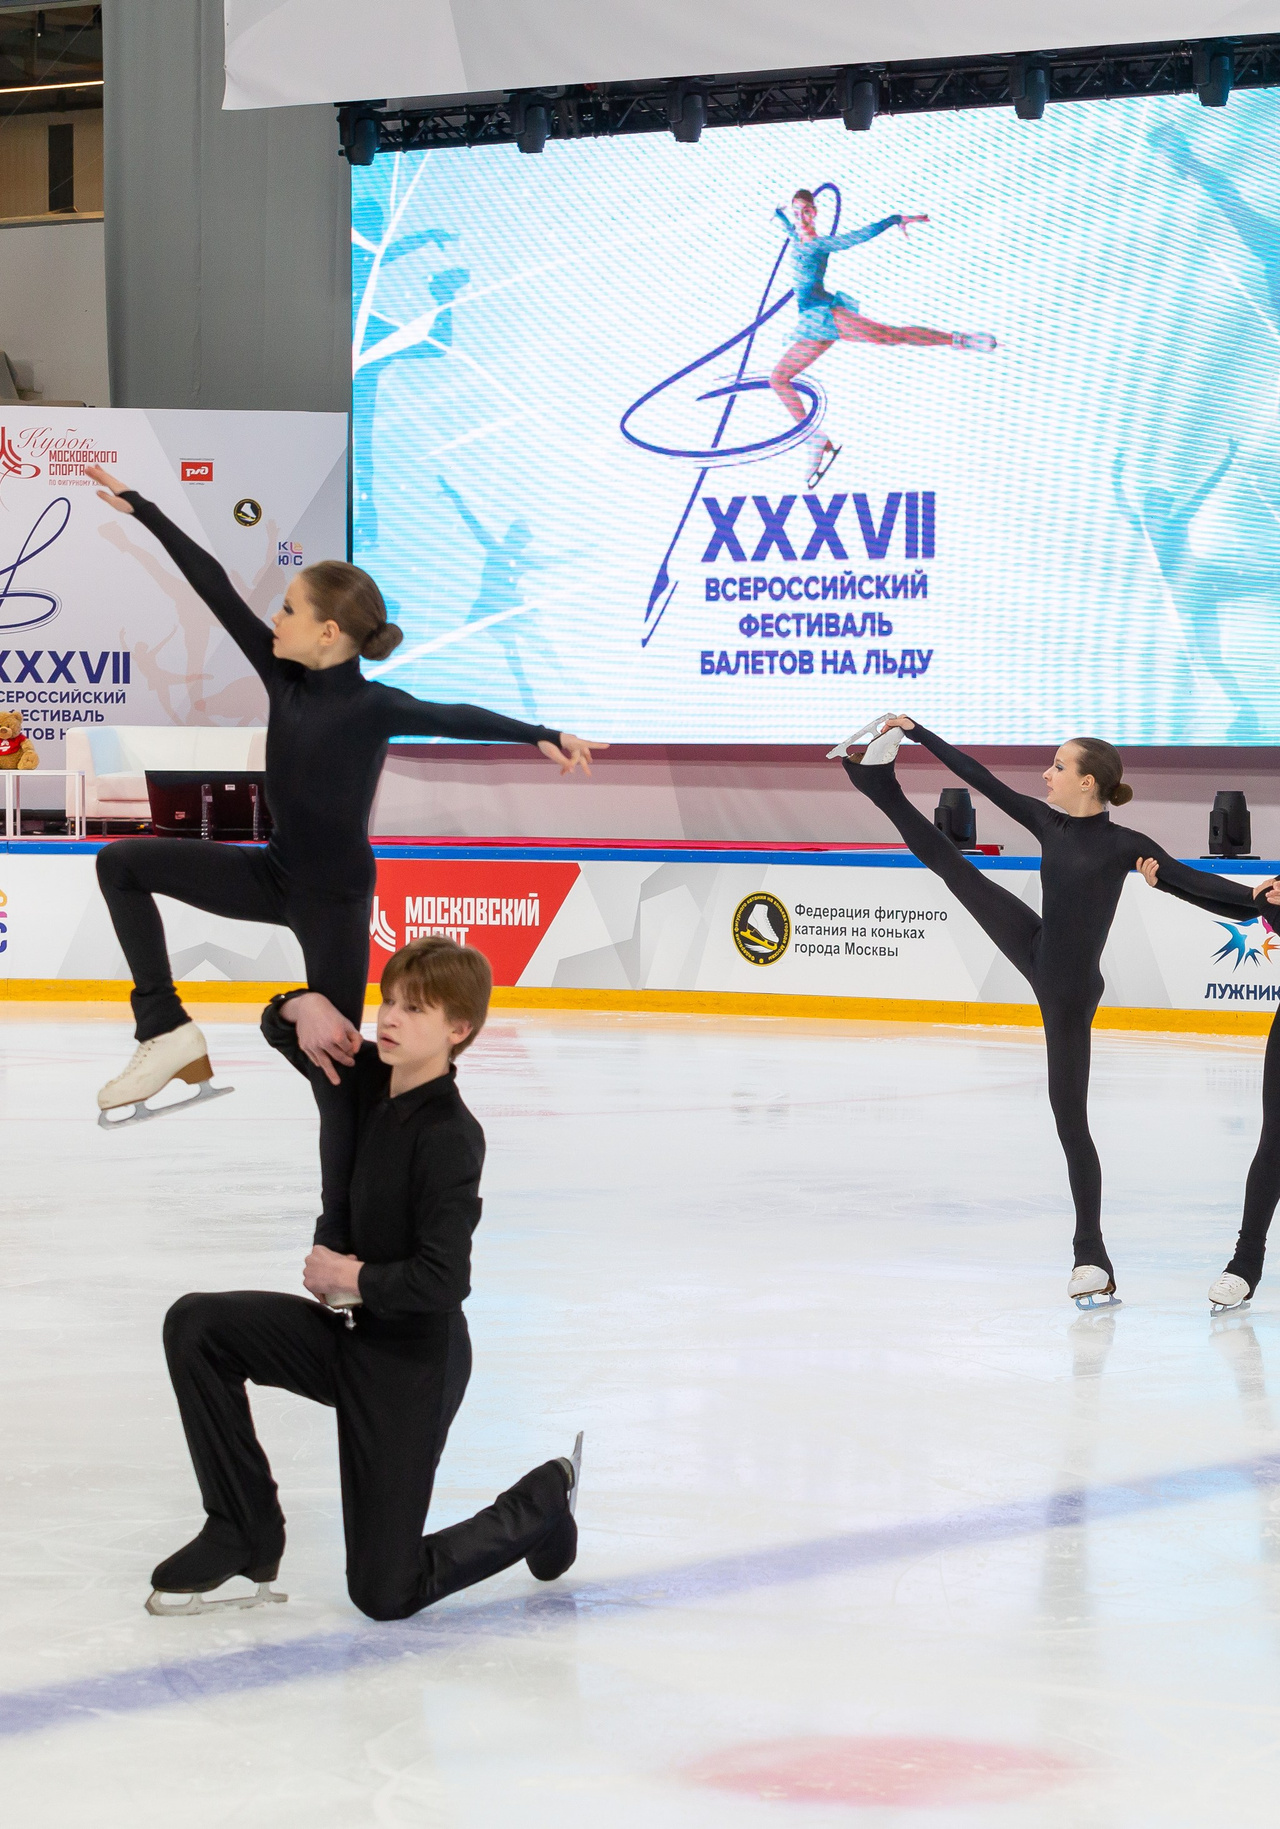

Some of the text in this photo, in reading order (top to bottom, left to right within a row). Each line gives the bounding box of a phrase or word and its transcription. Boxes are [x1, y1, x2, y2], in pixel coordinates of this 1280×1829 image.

[17, 427, 98, 457] Кубок
[49, 450, 117, 463] МОСКОВСКОГО
[49, 464, 85, 476] СПОРТА
[701, 491, 935, 562] XXXVII
[705, 569, 928, 601] ВСЕРОССИЙСКИЙ
[739, 612, 893, 638] ФЕСТИВАЛЬ
[700, 649, 934, 678] БАЛЕТОВ НА ЛЬДУ
[9, 709, 104, 722] ЕСТИВАЛЬ
[405, 892, 540, 926] МОСКОВСКИЙ
[794, 904, 948, 923] Федерация фигурного
[794, 924, 925, 939] катания на коньках
[794, 942, 898, 957] города Москвы
